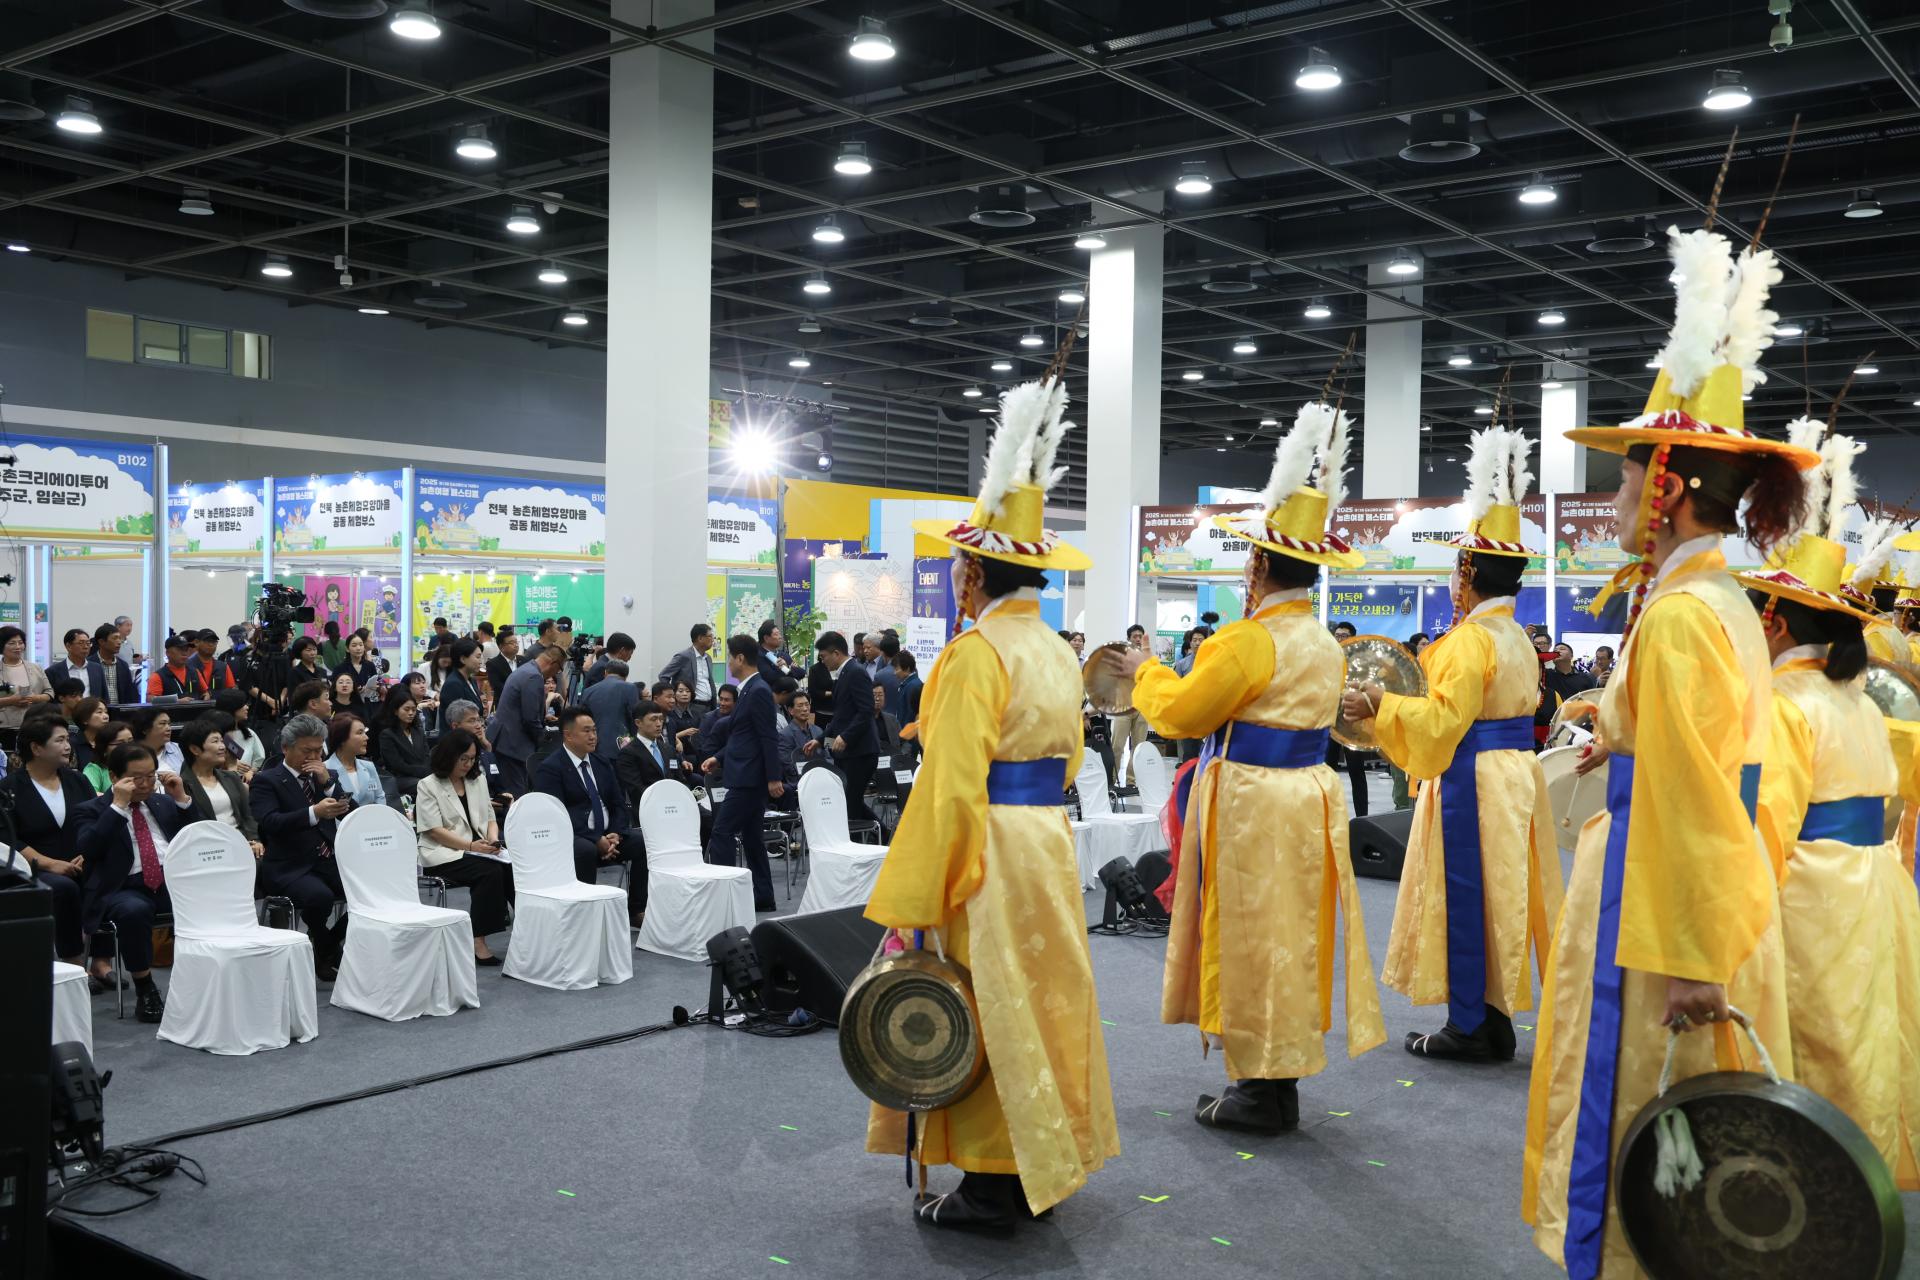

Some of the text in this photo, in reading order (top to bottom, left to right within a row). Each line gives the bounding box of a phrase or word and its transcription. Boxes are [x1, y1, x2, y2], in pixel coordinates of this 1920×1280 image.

[117, 454, 147, 467] B102
[0, 468, 109, 490] 촌크리에이투어
[36, 489, 87, 507] 임실군)
[591, 493, 605, 503] B10
[320, 499, 390, 514] 전북 농촌체험휴양마을
[488, 503, 587, 521] 전북 농촌체험휴양마을
[1560, 508, 1594, 518] 농촌여행
[333, 515, 375, 528] 공동 체험부스
[509, 519, 568, 534] 공동 체험부스
[709, 531, 740, 544] 체험부스
[1209, 528, 1240, 539] 하늘,
[1411, 531, 1463, 543] 반딧불이
[1222, 541, 1250, 552] 와흘메
[919, 572, 940, 586] EVENT
[1335, 592, 1363, 603] 가득한
[1331, 604, 1359, 616] 꽃구경
[1362, 604, 1396, 616] 오세요!
